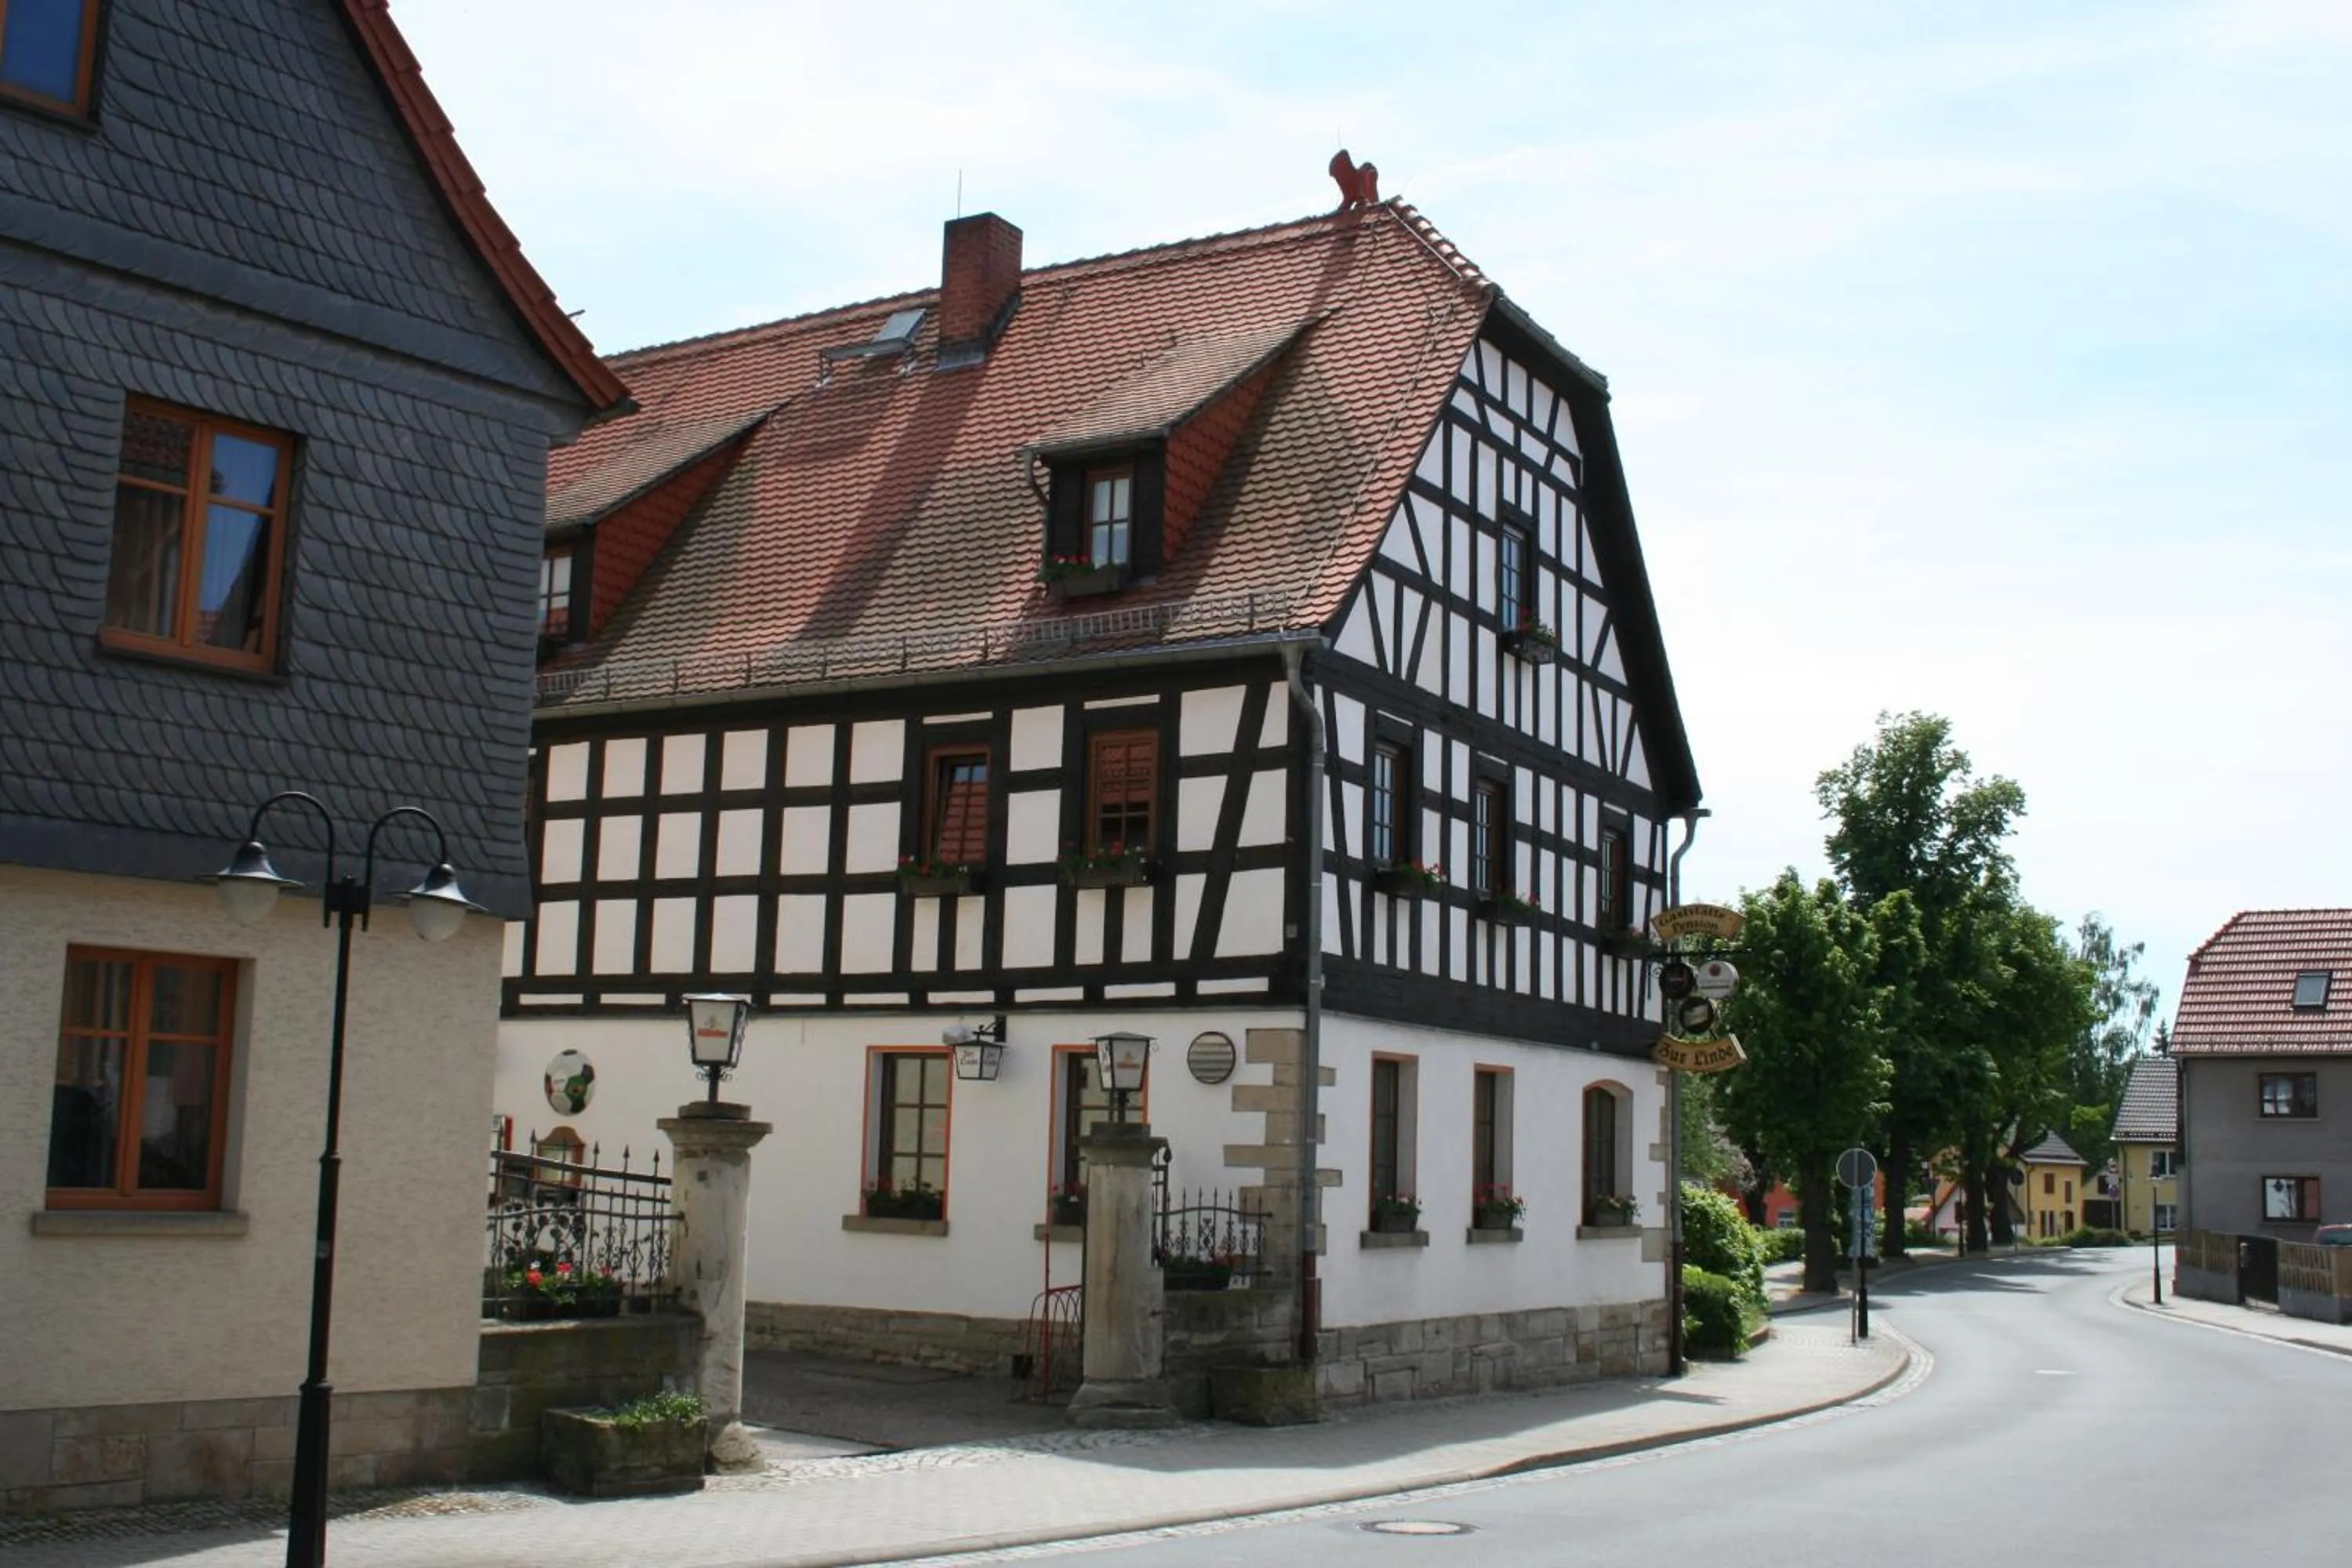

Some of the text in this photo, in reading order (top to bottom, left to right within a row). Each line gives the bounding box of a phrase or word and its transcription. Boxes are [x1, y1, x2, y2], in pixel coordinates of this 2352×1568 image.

[1672, 920, 1719, 932] Pension
[1658, 1043, 1733, 1065] Zur Linde
